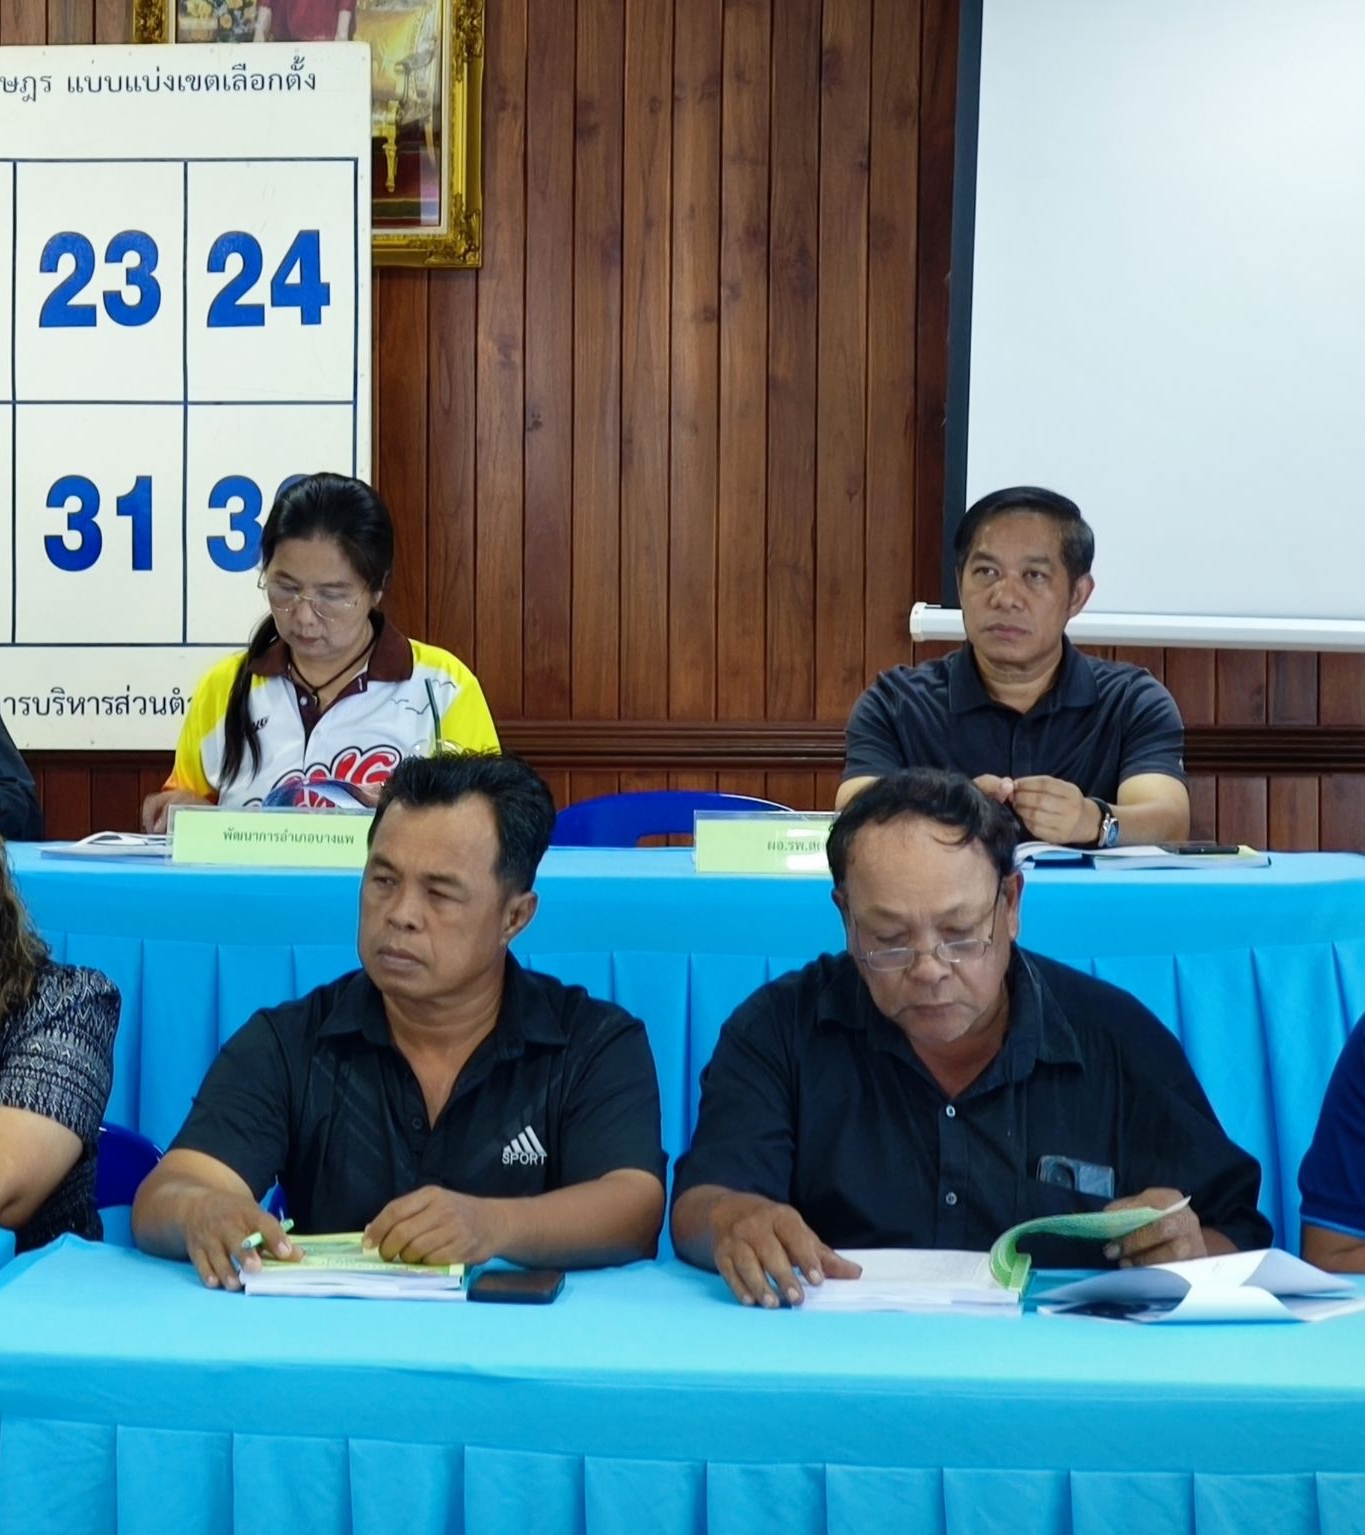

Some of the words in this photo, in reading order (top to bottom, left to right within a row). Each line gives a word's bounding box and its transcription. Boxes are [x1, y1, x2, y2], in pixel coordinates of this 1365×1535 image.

[67, 56, 316, 93] แบบแบ่งเขตเลือกตั้ง
[38, 230, 161, 327] 23
[206, 230, 330, 327] 24
[44, 475, 152, 571] 31
[502, 1152, 546, 1166] SPORT
